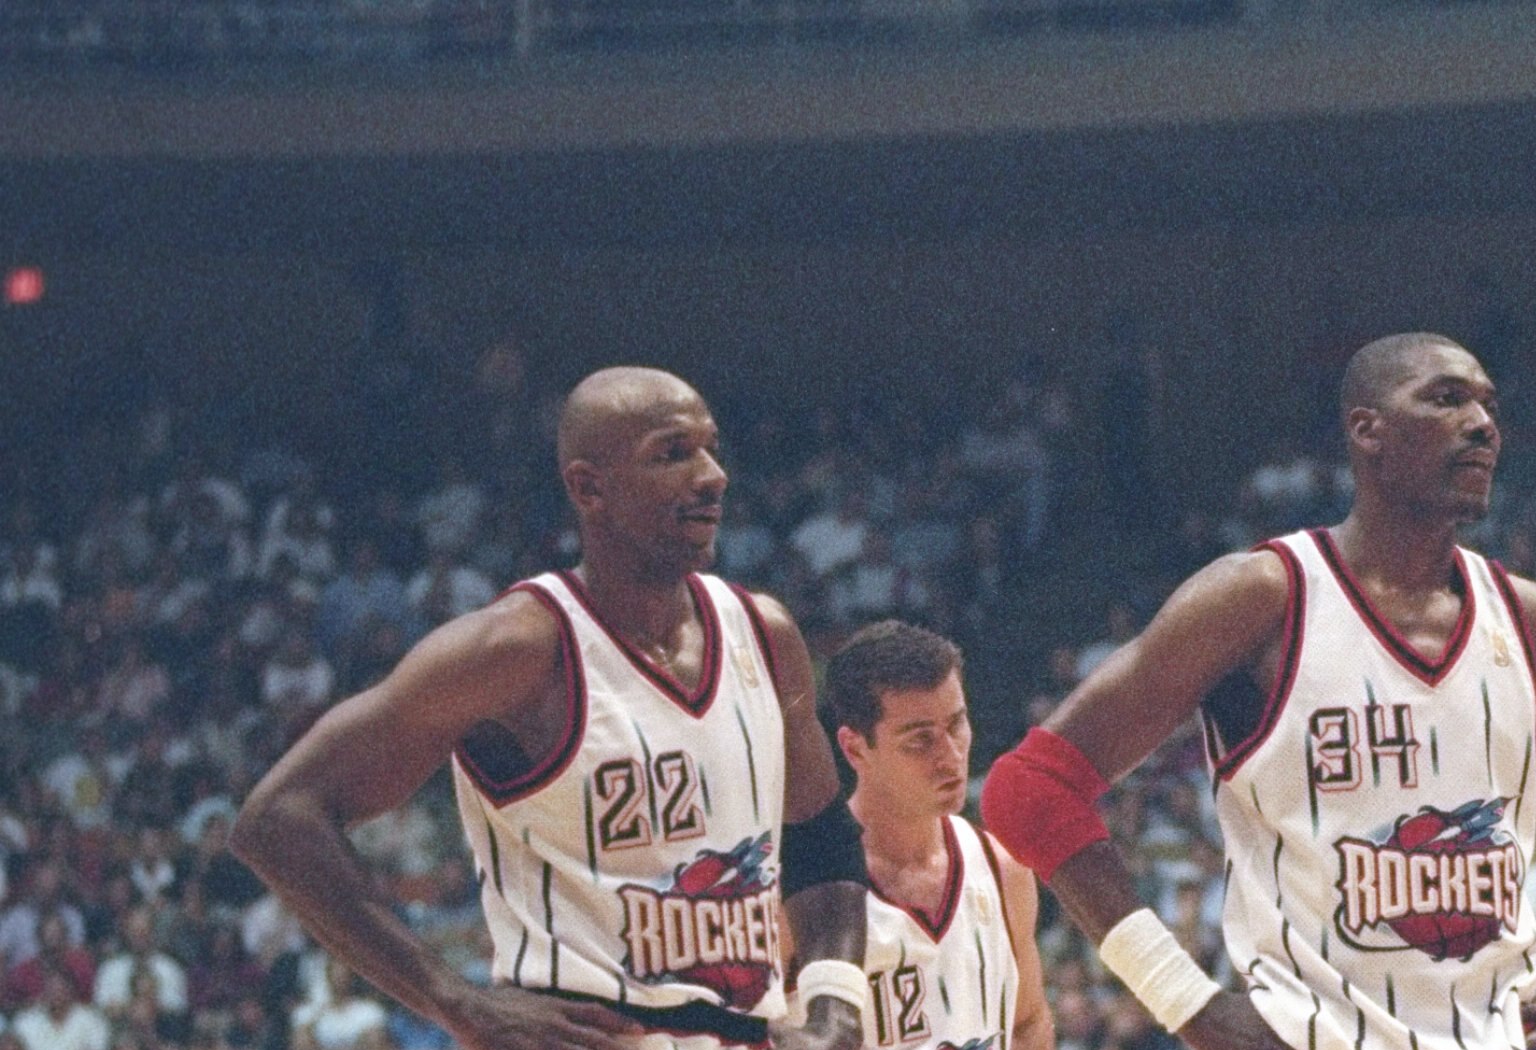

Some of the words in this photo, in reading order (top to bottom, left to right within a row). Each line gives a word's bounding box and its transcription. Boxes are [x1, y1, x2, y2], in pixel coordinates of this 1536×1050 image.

[1308, 703, 1420, 793] 34
[593, 749, 706, 852] 22
[1336, 839, 1521, 936] ROCKETS
[867, 964, 932, 1047] 12
